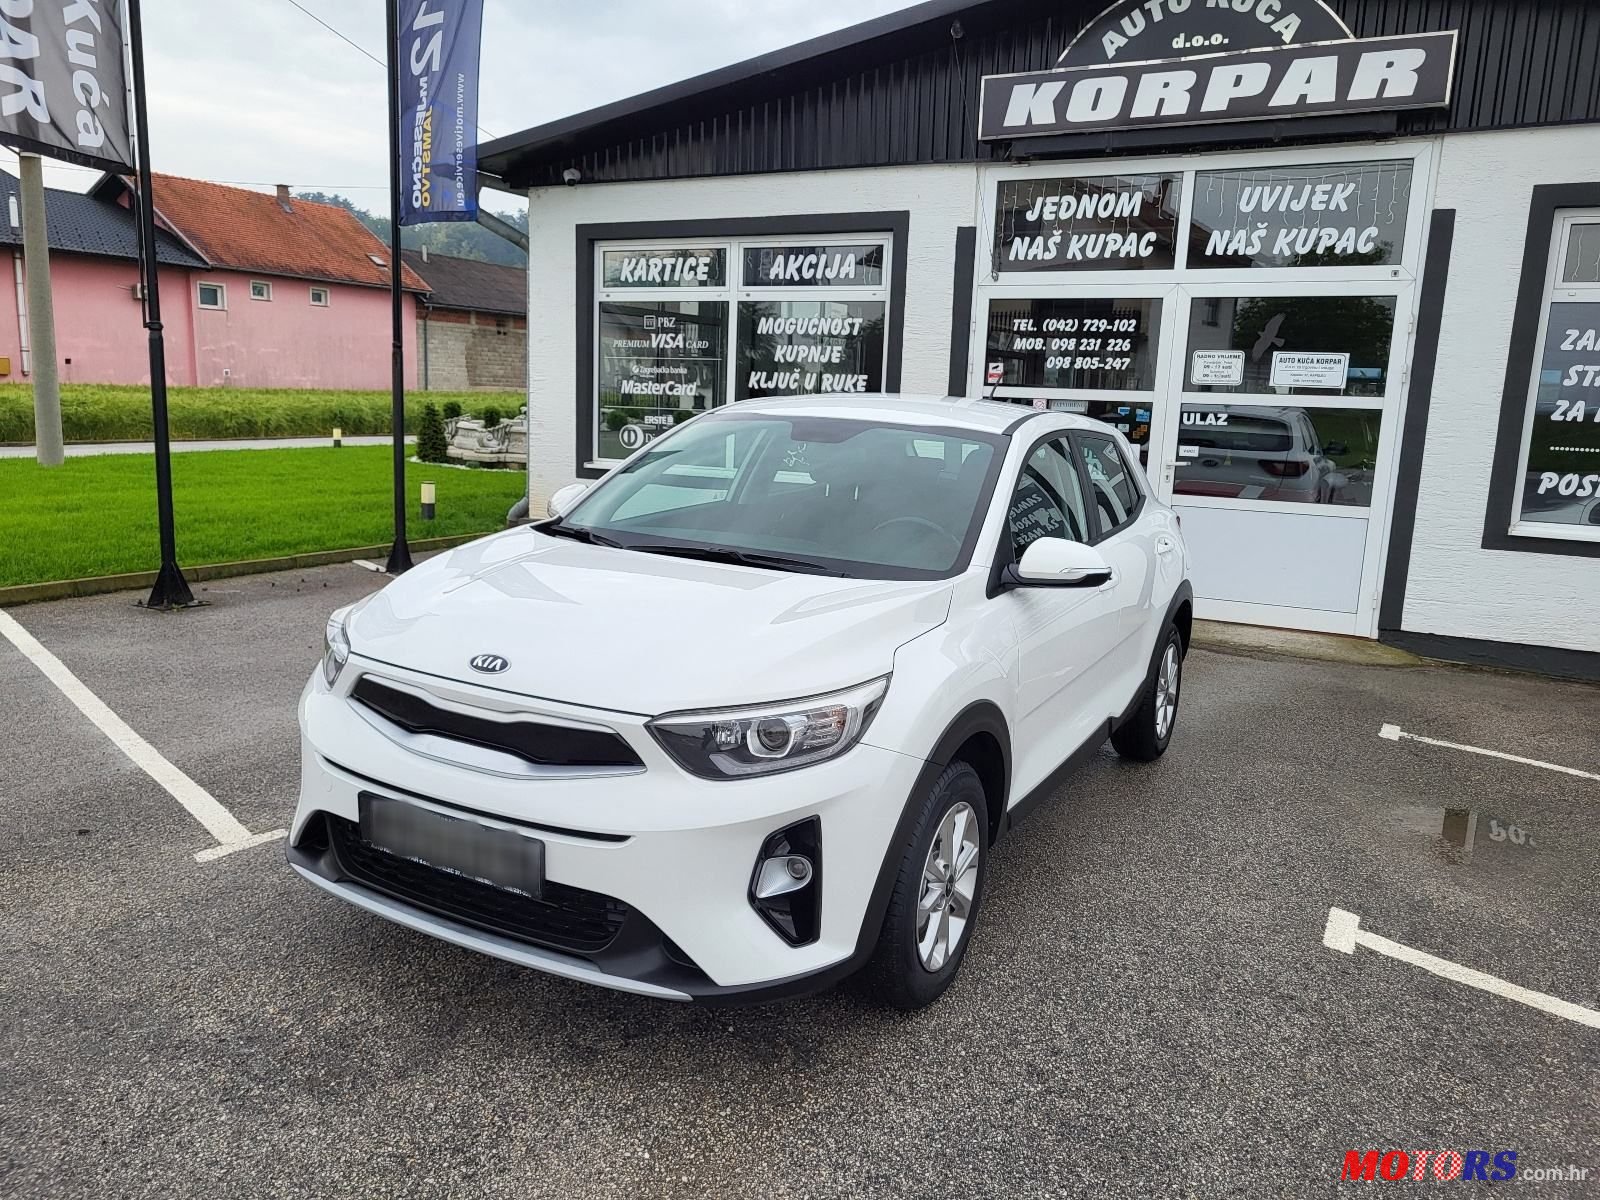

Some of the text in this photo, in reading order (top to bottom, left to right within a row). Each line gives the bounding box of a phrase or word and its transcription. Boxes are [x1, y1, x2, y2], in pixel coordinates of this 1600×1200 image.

[1101, 0, 1192, 59] AUTO
[1172, 32, 1229, 48] d.o.o.
[1003, 48, 1426, 128] KORPAR
[1026, 191, 1143, 223] JEDNOM
[1239, 182, 1356, 213] UVIJEK
[1009, 230, 1157, 261] NAŠ KUPAC
[1205, 222, 1379, 257] NAŠ KUPAC
[620, 256, 710, 283] KARTICE
[769, 253, 856, 281] AKCIJA
[657, 316, 676, 328] PBZ
[757, 313, 863, 336] MOGUĆNOST
[1013, 318, 1137, 332] TEL. (042) 729-102
[613, 333, 709, 349] PREMIUM VISA CARD
[1013, 338, 1131, 351] MOB. 098 231 226
[1560, 328, 1600, 351] ZA
[774, 345, 843, 363] KUPNJE
[1046, 356, 1131, 370] 098 805-247
[621, 380, 698, 396] MasterCard
[748, 368, 868, 393] KLJUČ U RUKE
[644, 415, 667, 425] ERSTE
[1182, 412, 1228, 426] ULAZ
[1550, 399, 1586, 422] ZA
[1537, 471, 1600, 498] POS
[472, 655, 503, 671] KIA
